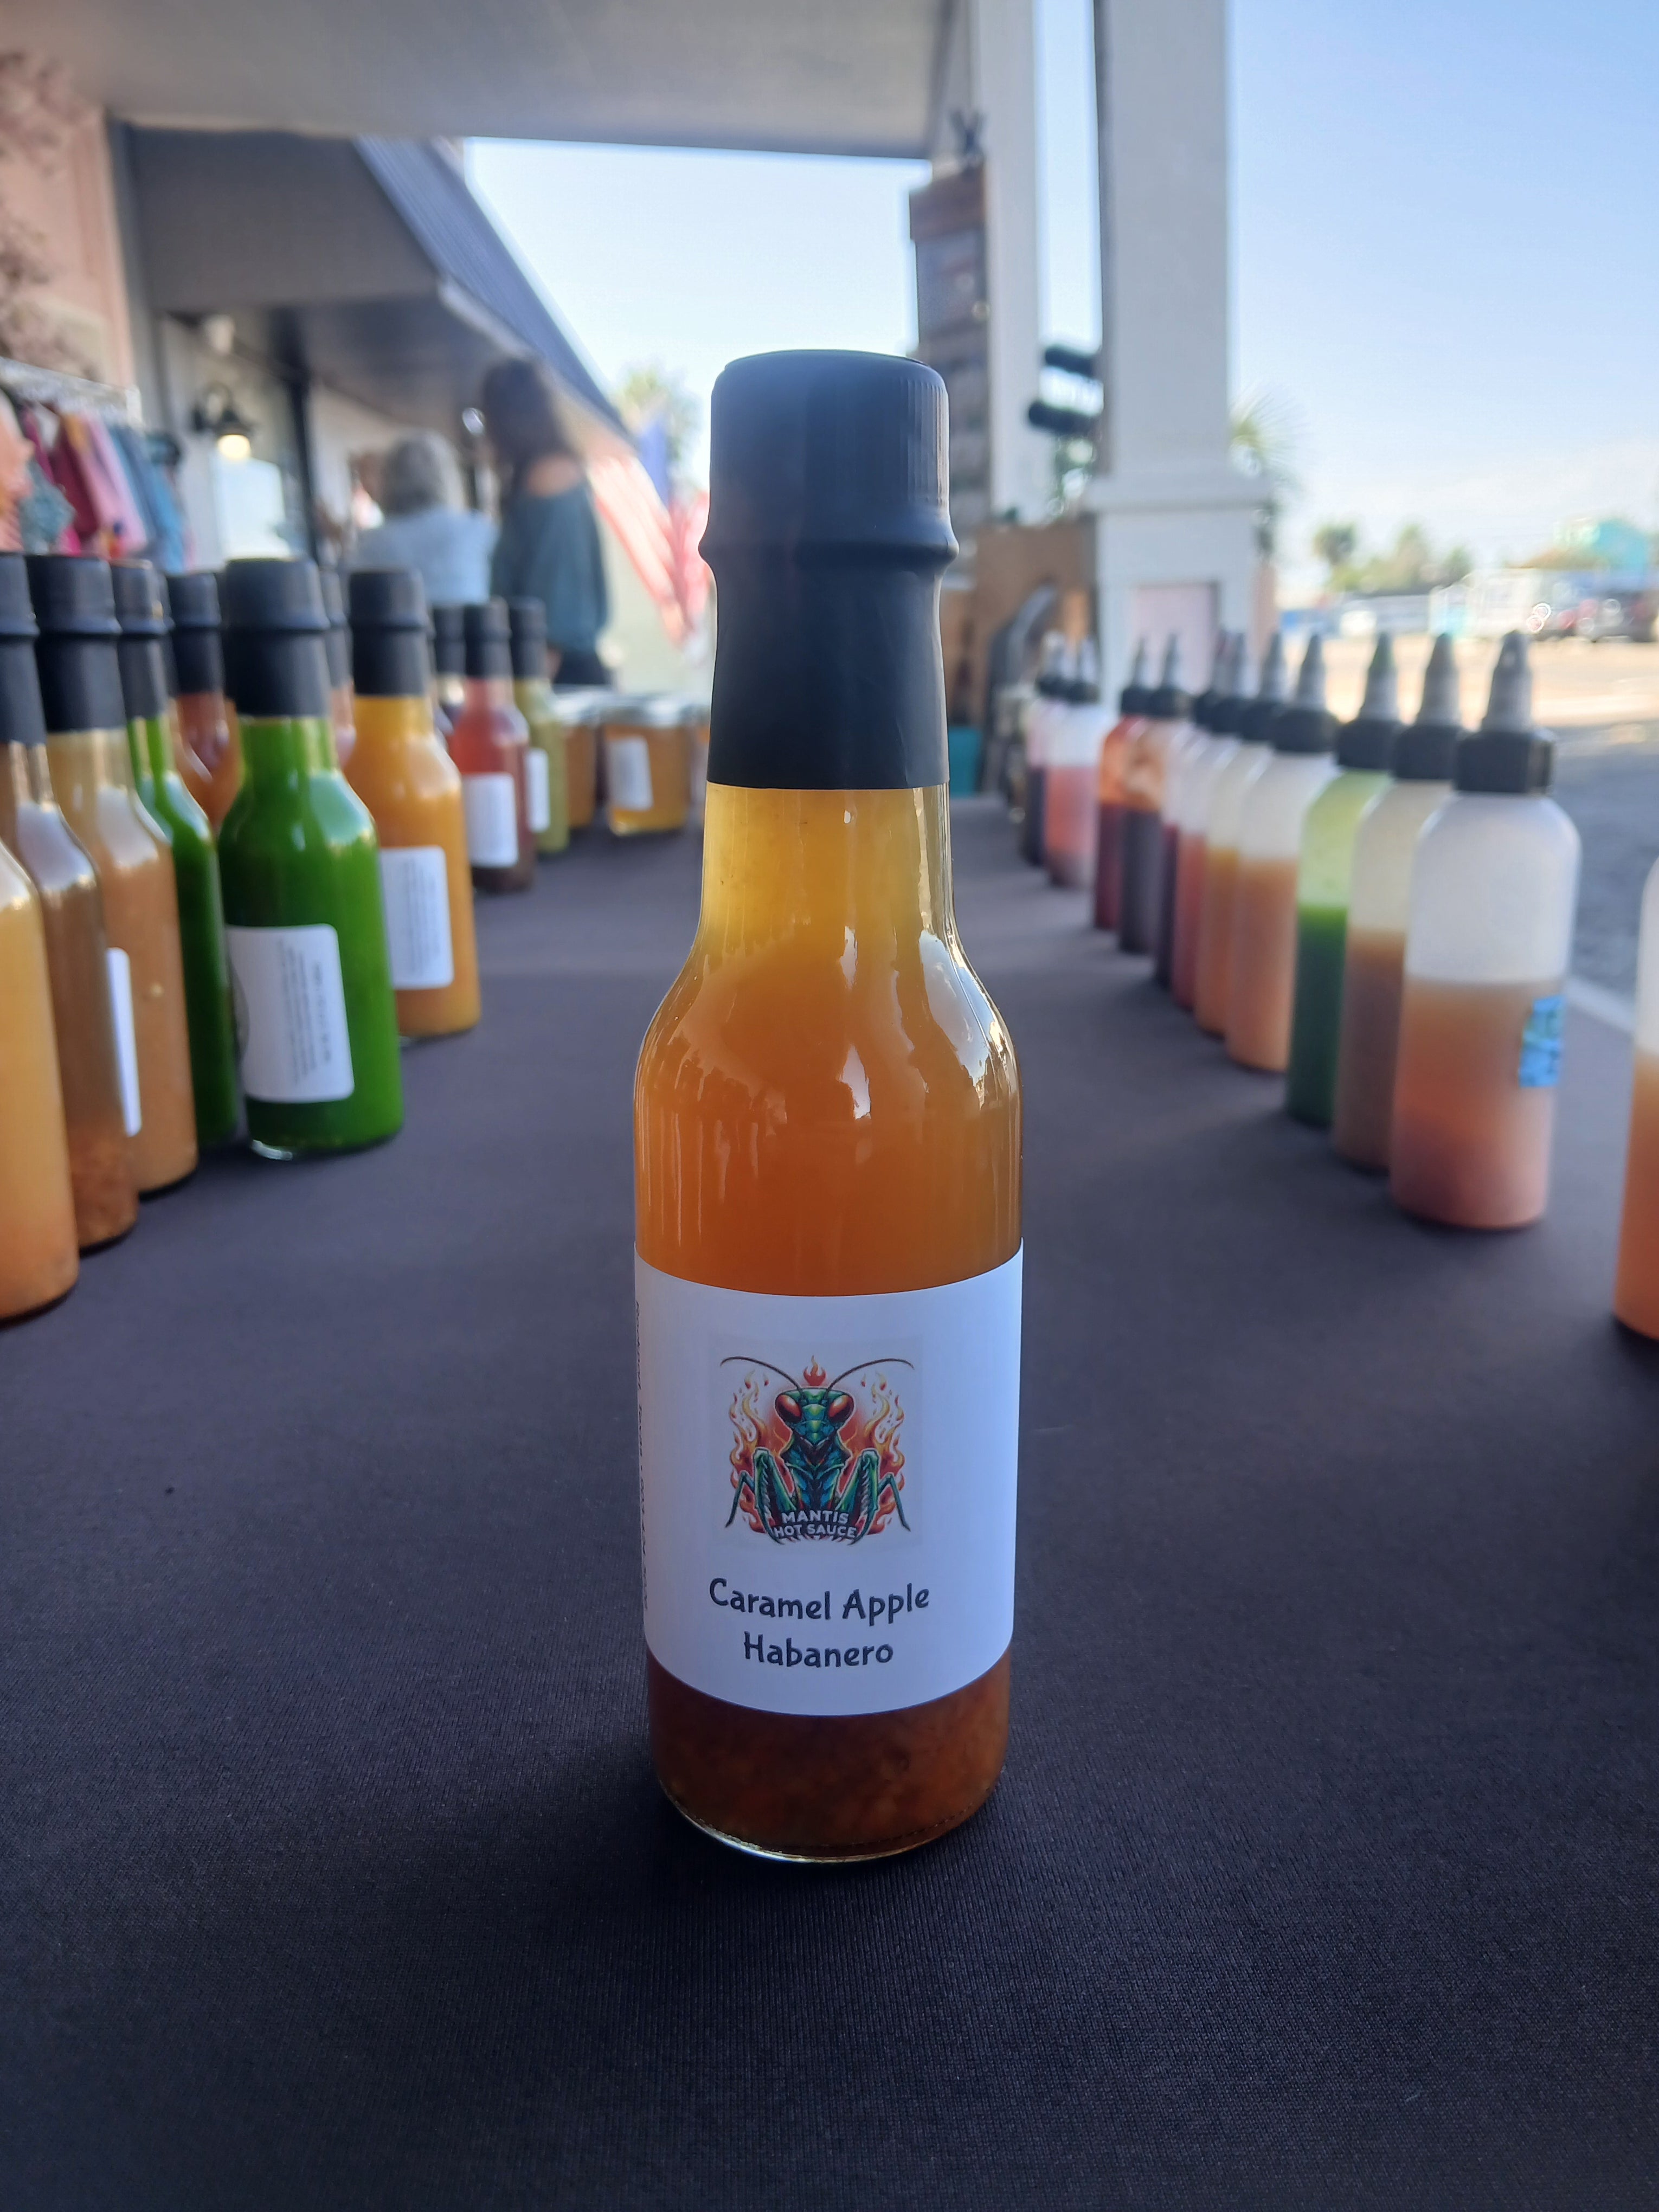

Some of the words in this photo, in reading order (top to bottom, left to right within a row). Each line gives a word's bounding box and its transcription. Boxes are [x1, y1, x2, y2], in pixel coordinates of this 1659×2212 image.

[781, 1510, 849, 1525] MANTIS
[774, 1524, 802, 1538] HOT
[807, 1524, 857, 1538] SAUCE
[709, 1577, 831, 1620] Caramel
[842, 1583, 930, 1626] Apple
[743, 1631, 894, 1668] Habanero
